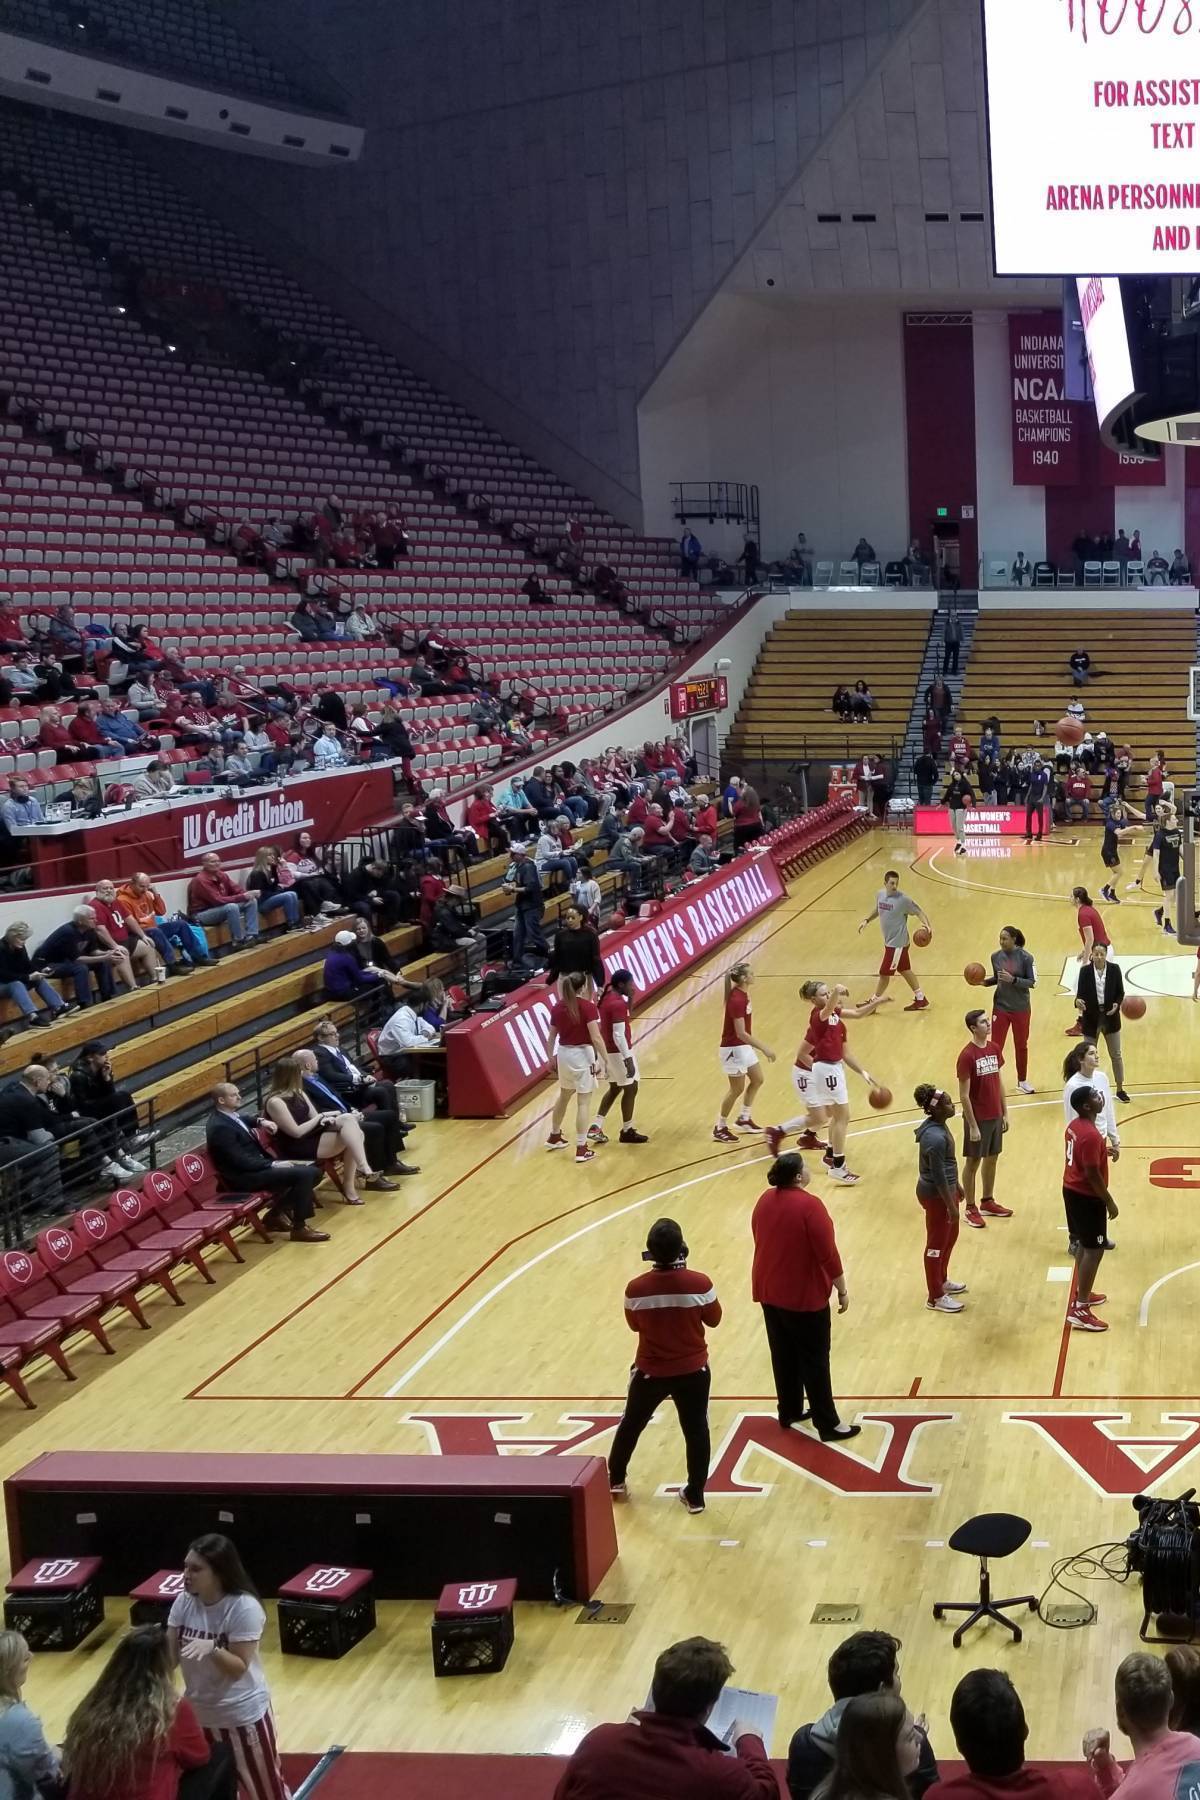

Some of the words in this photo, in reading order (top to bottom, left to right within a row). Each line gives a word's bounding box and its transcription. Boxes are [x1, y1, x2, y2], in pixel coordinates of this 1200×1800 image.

[1094, 81, 1128, 107] FOR
[1151, 123, 1195, 148] TEXT
[1047, 185, 1104, 210] ARENA
[1153, 226, 1190, 250] AND
[1020, 335, 1064, 350] INDIANA
[1014, 354, 1064, 369] UNIVERSIT
[1016, 409, 1072, 424] BASKETBALL
[1018, 427, 1071, 442] CHAMPIONS
[1032, 450, 1059, 464] 1940
[183, 814, 200, 850] IU
[205, 802, 254, 843] Credit
[259, 793, 304, 830] Union
[980, 811, 1011, 821] WOMEN'S
[686, 863, 772, 947] BASKETBALL
